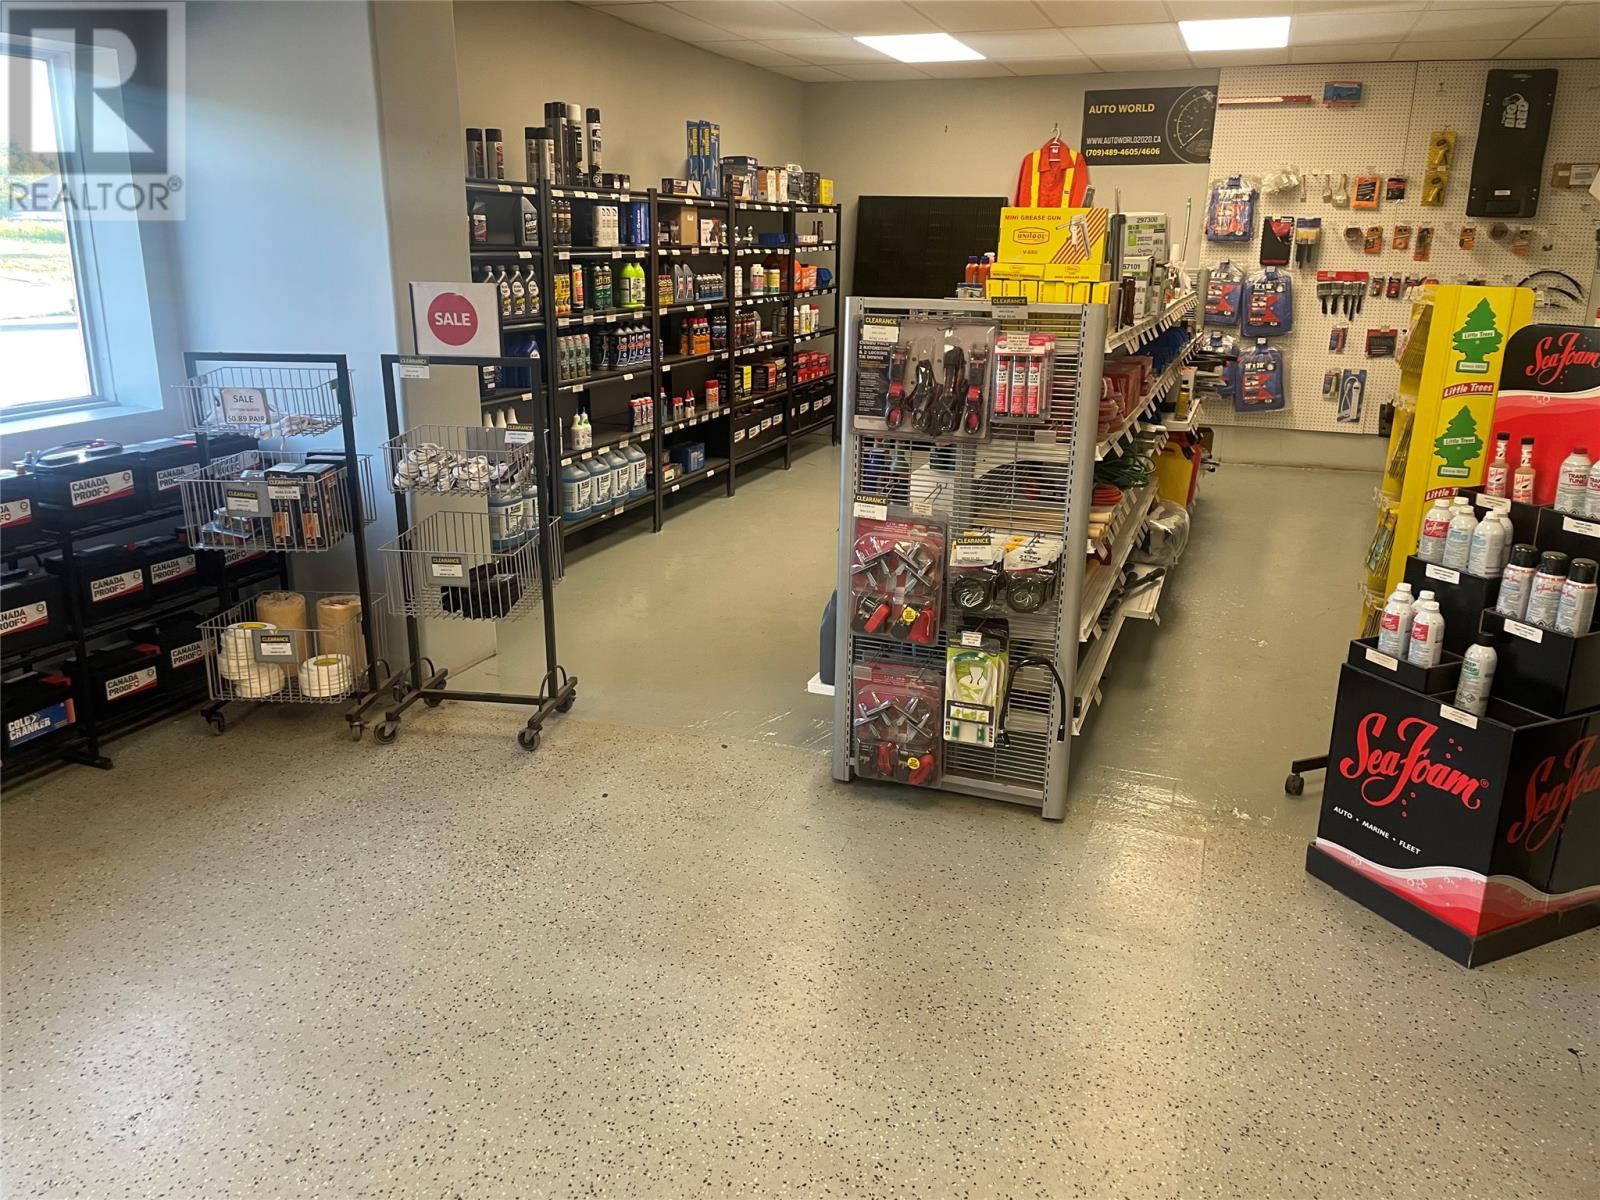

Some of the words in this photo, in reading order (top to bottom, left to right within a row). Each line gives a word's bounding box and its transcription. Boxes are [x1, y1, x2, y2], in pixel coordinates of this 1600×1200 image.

[1088, 104, 1117, 114] AUTO
[1118, 103, 1155, 113] WORLD
[1086, 135, 1162, 145] WWW.AUTOWORLD2020.CA
[1085, 147, 1161, 157] (709)489-4605/4606
[434, 312, 472, 326] SALE
[865, 317, 897, 325] CLEARANCE
[1444, 384, 1468, 397] Little
[1470, 383, 1493, 392] Trees
[232, 394, 255, 404] SALE
[158, 468, 185, 480] CANADA
[72, 475, 108, 492] CANADA
[73, 487, 104, 502] PROOF
[228, 490, 257, 498] CLEARANCE
[856, 495, 887, 505] CLEARANCE
[1426, 488, 1450, 500] Little
[152, 561, 180, 573] CANADA
[153, 568, 176, 581] PROOF
[92, 576, 125, 590] CANADA
[94, 584, 120, 597] PROOF
[0, 618, 20, 631] ROOF
[172, 643, 201, 657] CANADA
[173, 651, 196, 664] PROOF
[107, 673, 139, 688] CANADA
[108, 682, 134, 697] PROOF
[8, 715, 31, 731] COLD
[9, 717, 51, 741] CRANKER
[1333, 805, 1353, 820] AUTO
[1362, 820, 1390, 840] MARINE
[1398, 839, 1422, 856] FLEET
